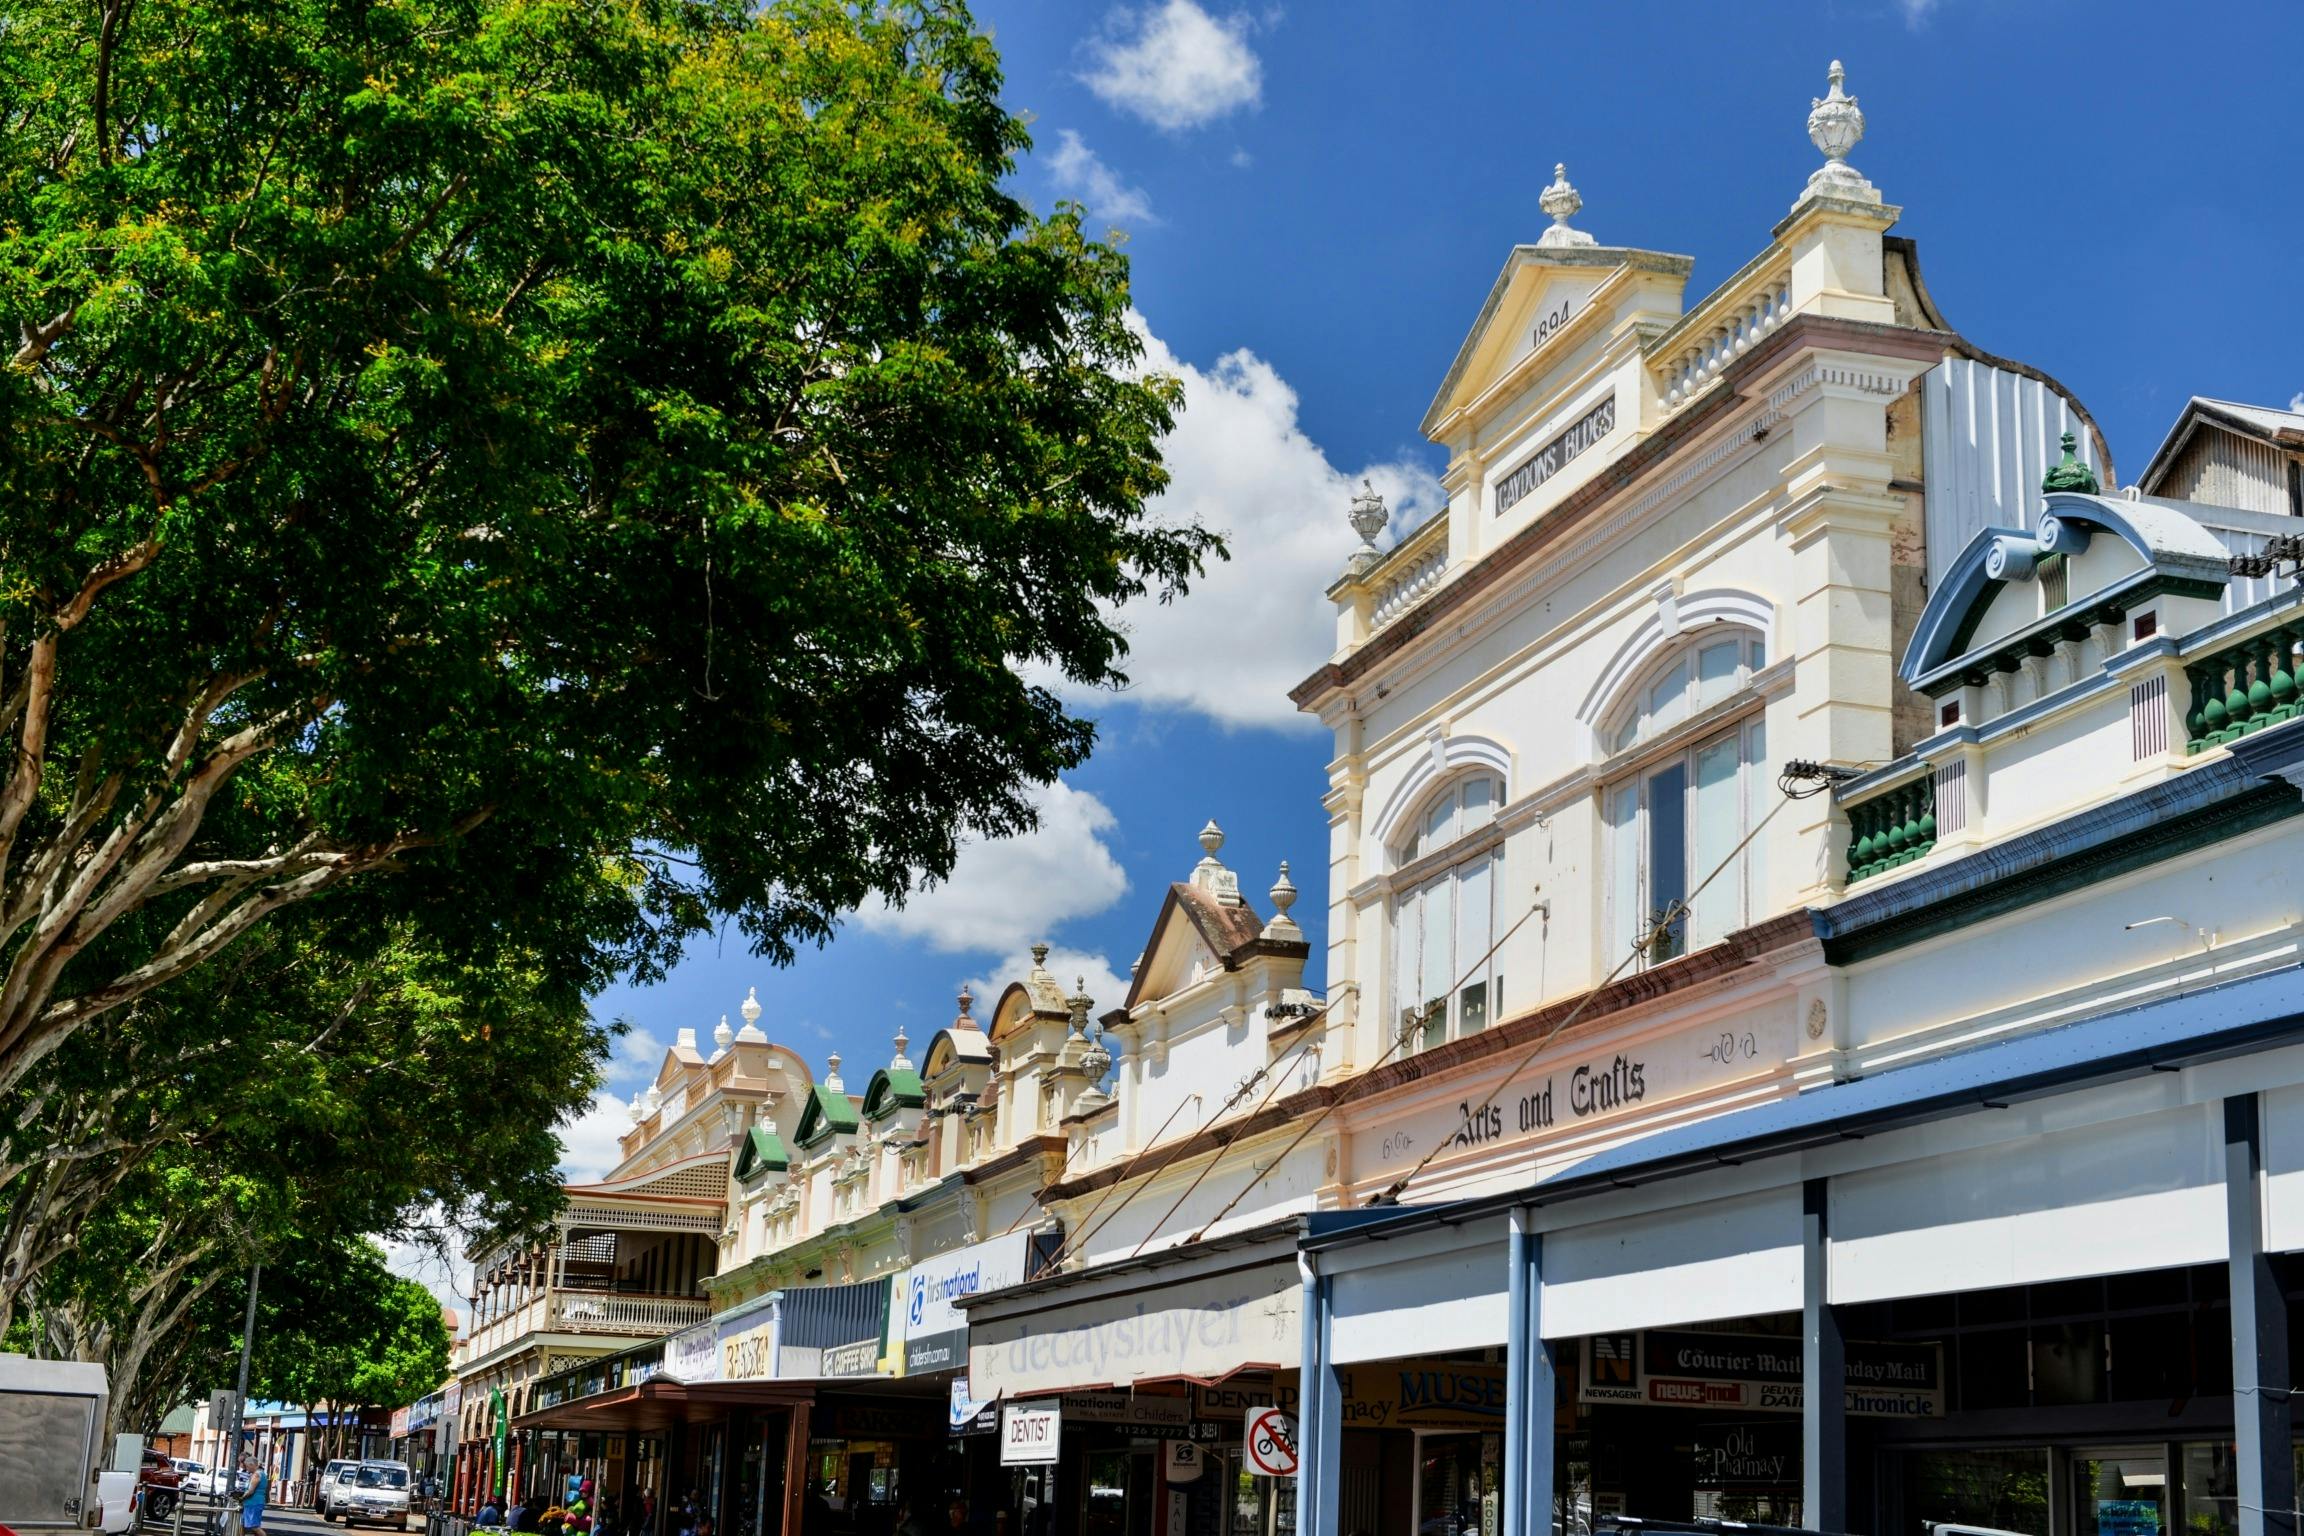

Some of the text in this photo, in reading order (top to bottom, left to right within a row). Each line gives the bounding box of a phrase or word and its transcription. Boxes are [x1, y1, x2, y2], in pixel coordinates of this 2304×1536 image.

[1533, 300, 1570, 348] 1894
[1565, 401, 1615, 464] BLDGS
[1455, 1052, 1645, 1150] Arts and Crafts
[1008, 1296, 1250, 1377] decayslayer
[834, 1345, 878, 1373] COFFEE SHOP
[1677, 1347, 1802, 1373] Courier-Mail
[1885, 1361, 1927, 1380] Mail
[1585, 1388, 1642, 1400] NEWSAGENT
[1134, 1407, 1184, 1423] Childers
[1011, 1417, 1051, 1443] DENTIST
[1113, 1425, 1183, 1437] 4126 2777
[1726, 1427, 1754, 1456] Old
[1709, 1448, 1785, 1484] Pharmacy
